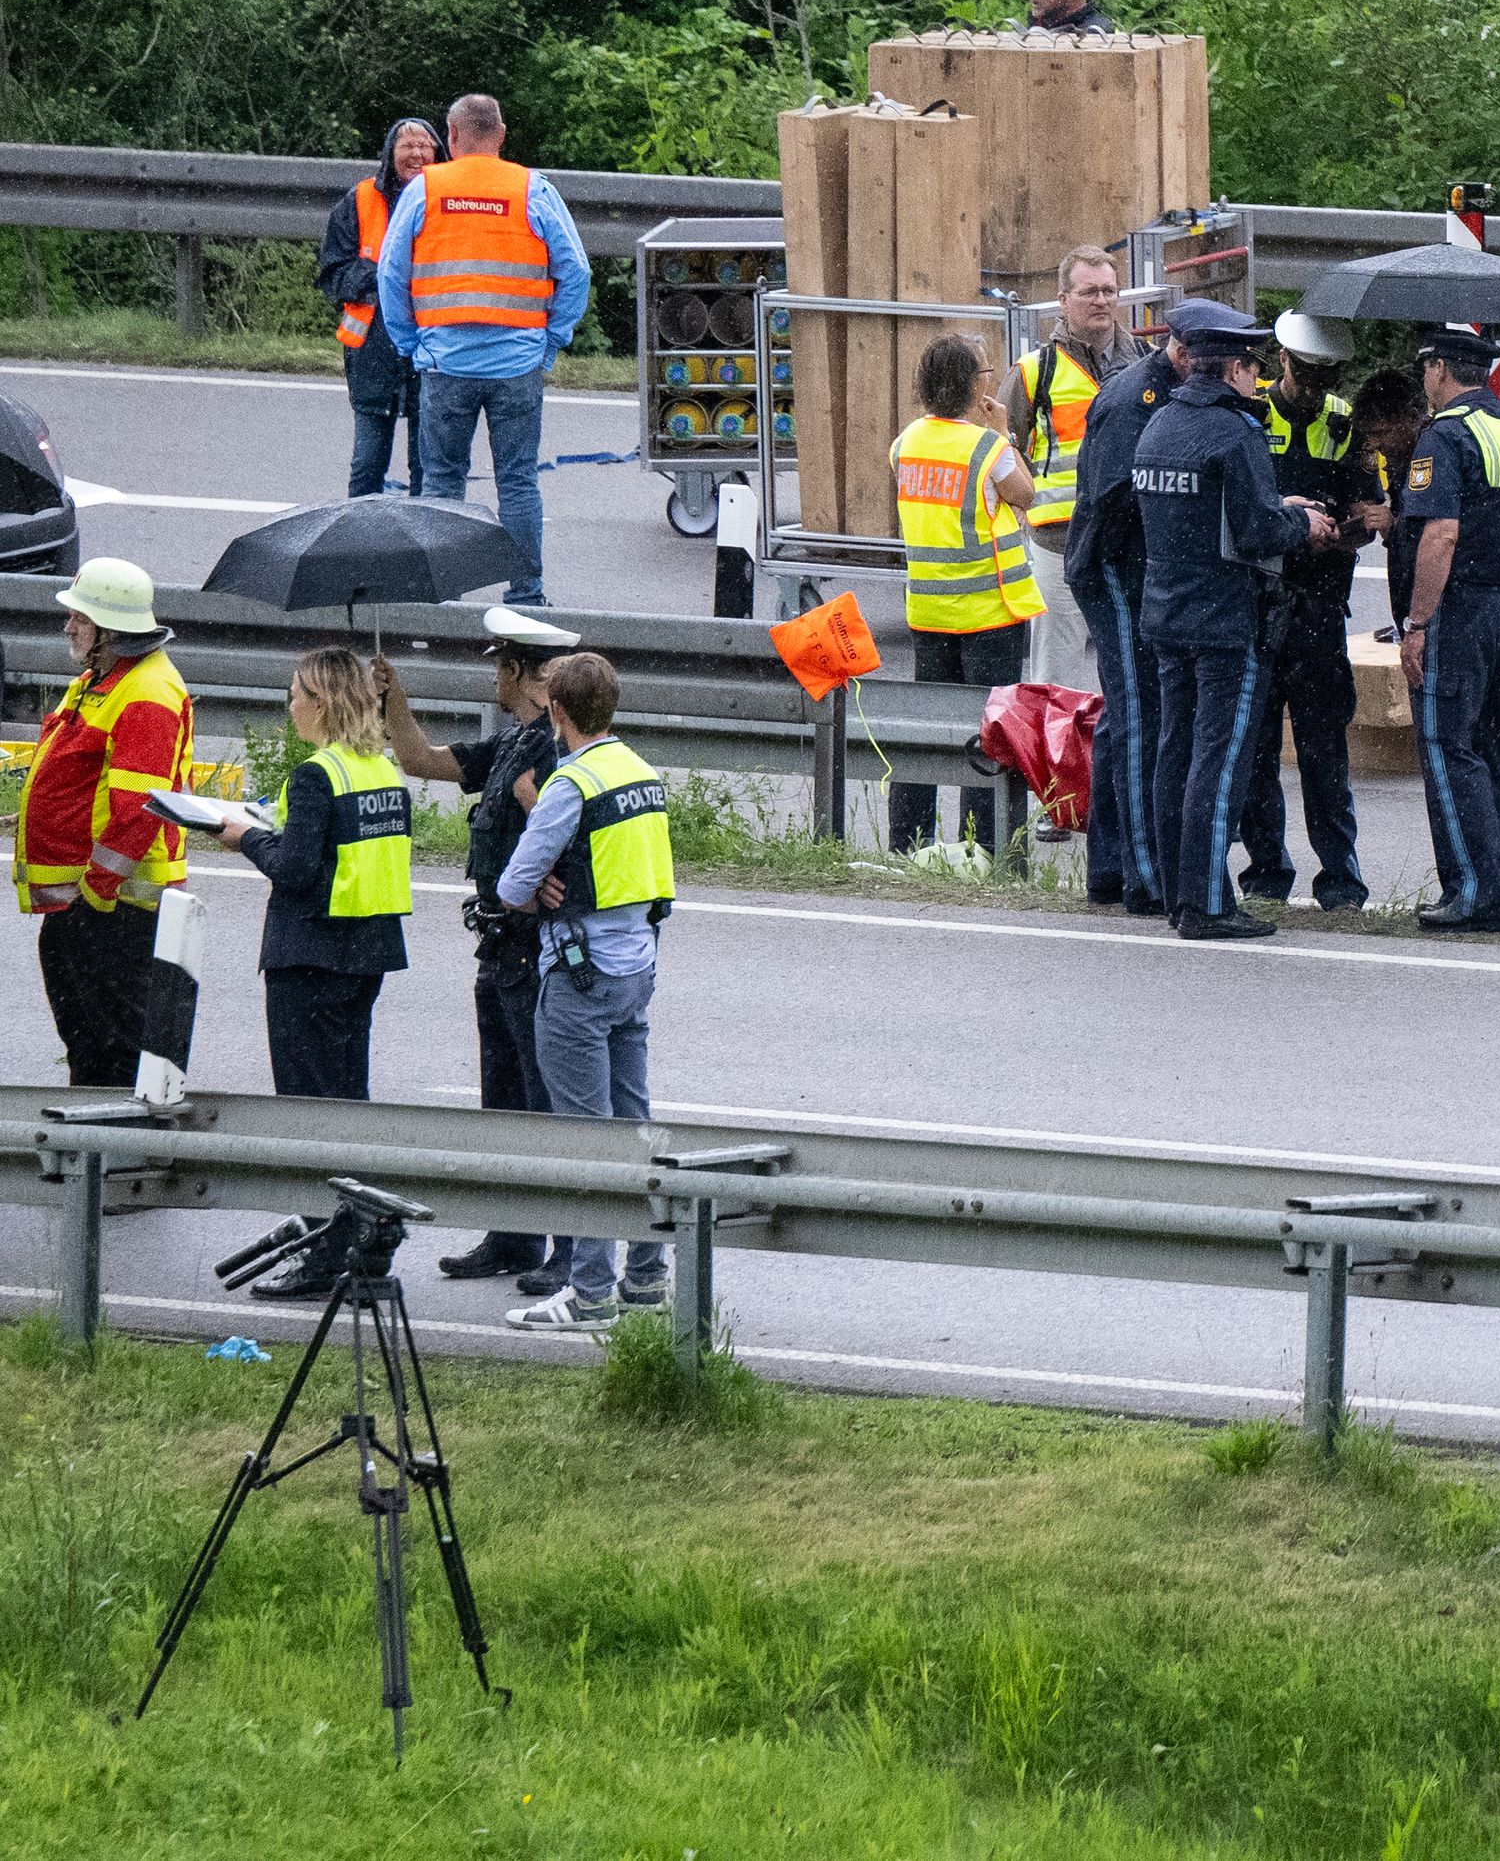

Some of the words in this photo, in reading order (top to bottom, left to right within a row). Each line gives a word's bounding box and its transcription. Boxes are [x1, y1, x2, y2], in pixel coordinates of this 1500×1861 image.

[447, 199, 504, 215] Betreuung
[898, 464, 963, 501] POLIZEI
[1131, 469, 1200, 493] POLIZEI
[833, 612, 858, 660] holmatro
[358, 790, 404, 815] POLIZE
[615, 785, 665, 814] POLIZE
